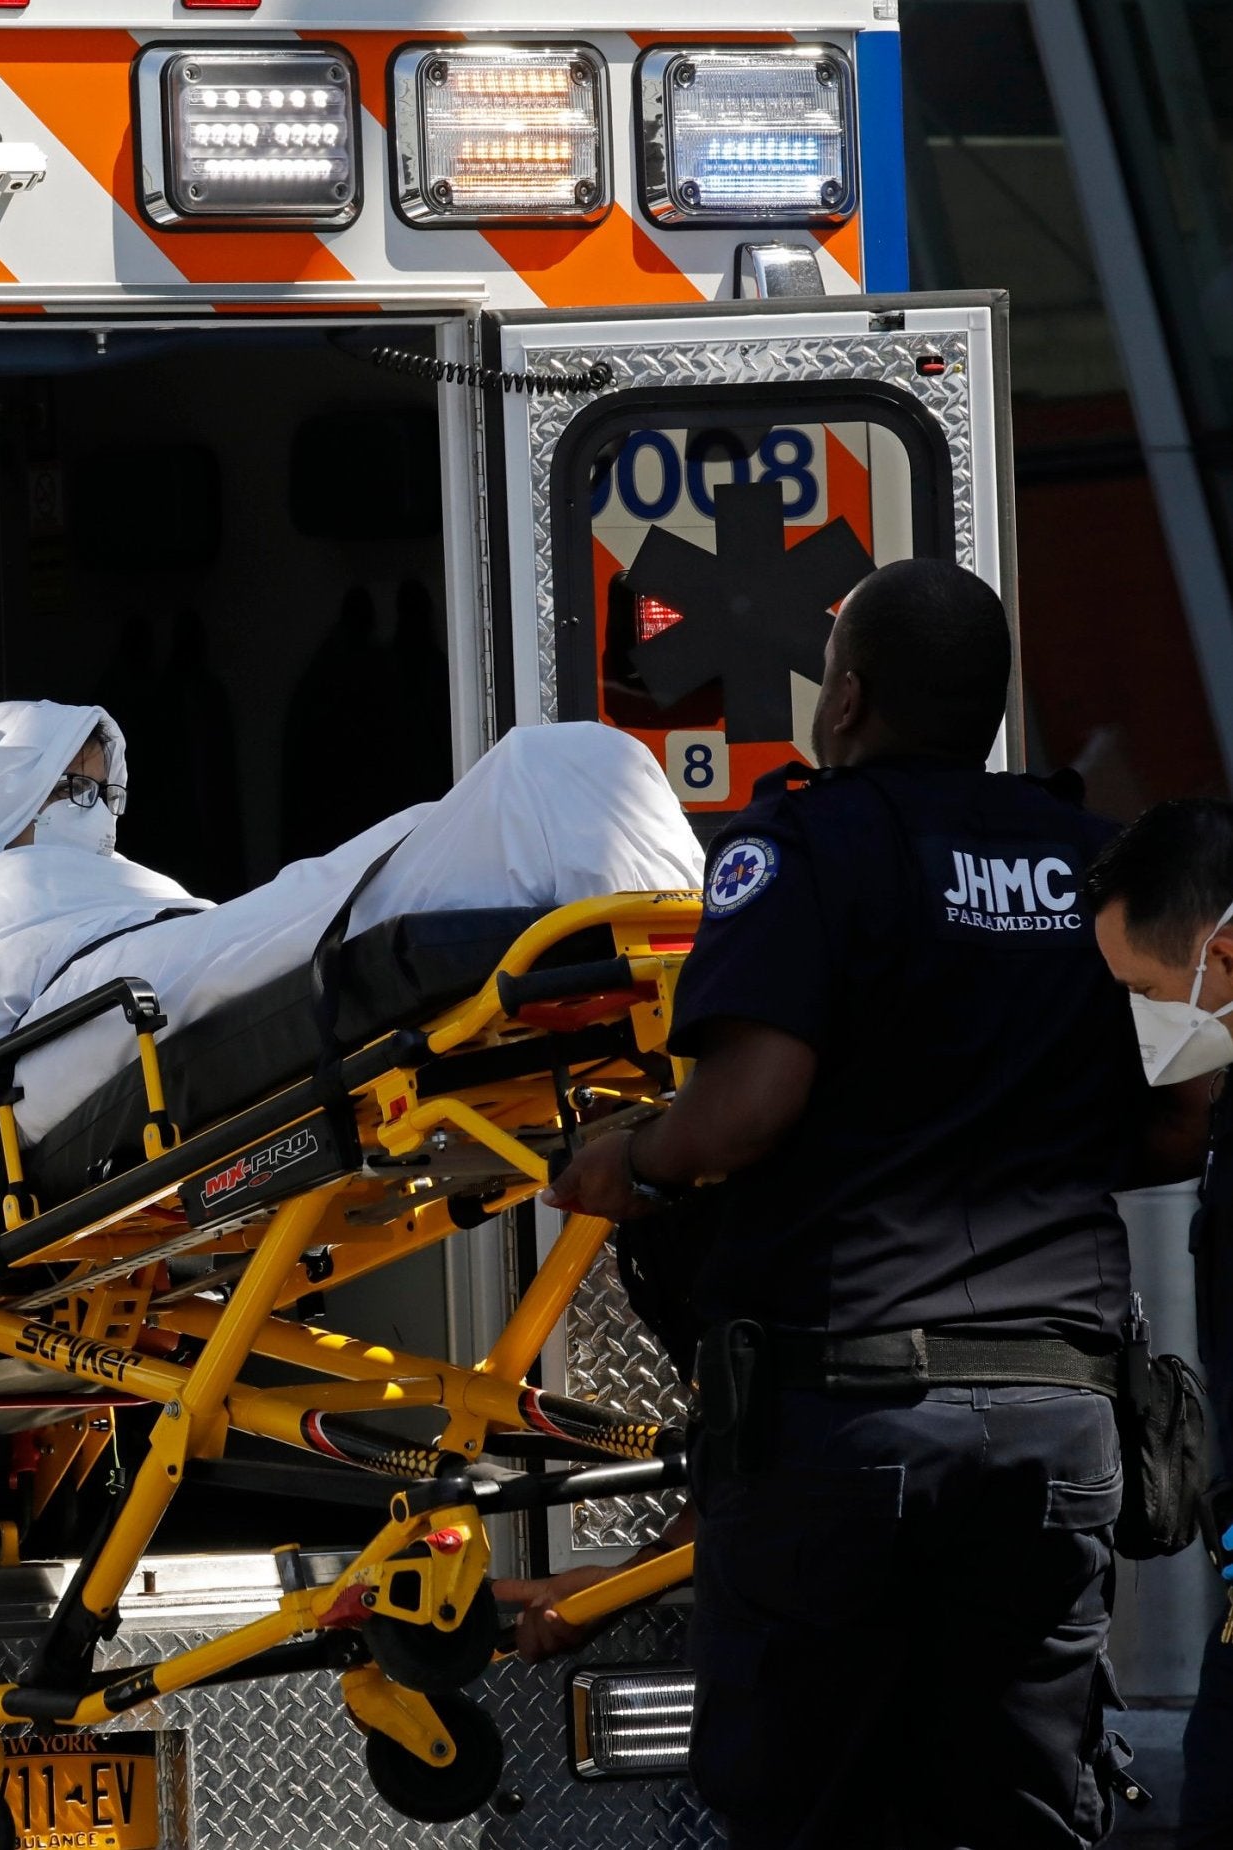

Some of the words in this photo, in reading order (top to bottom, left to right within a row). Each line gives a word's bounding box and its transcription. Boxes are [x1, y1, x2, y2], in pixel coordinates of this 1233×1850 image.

[683, 744, 714, 789] 8
[943, 850, 1077, 913] JHMC
[945, 906, 1083, 932] PARAMEDIC
[39, 1735, 98, 1753] YORK
[90, 1760, 135, 1828] EV
